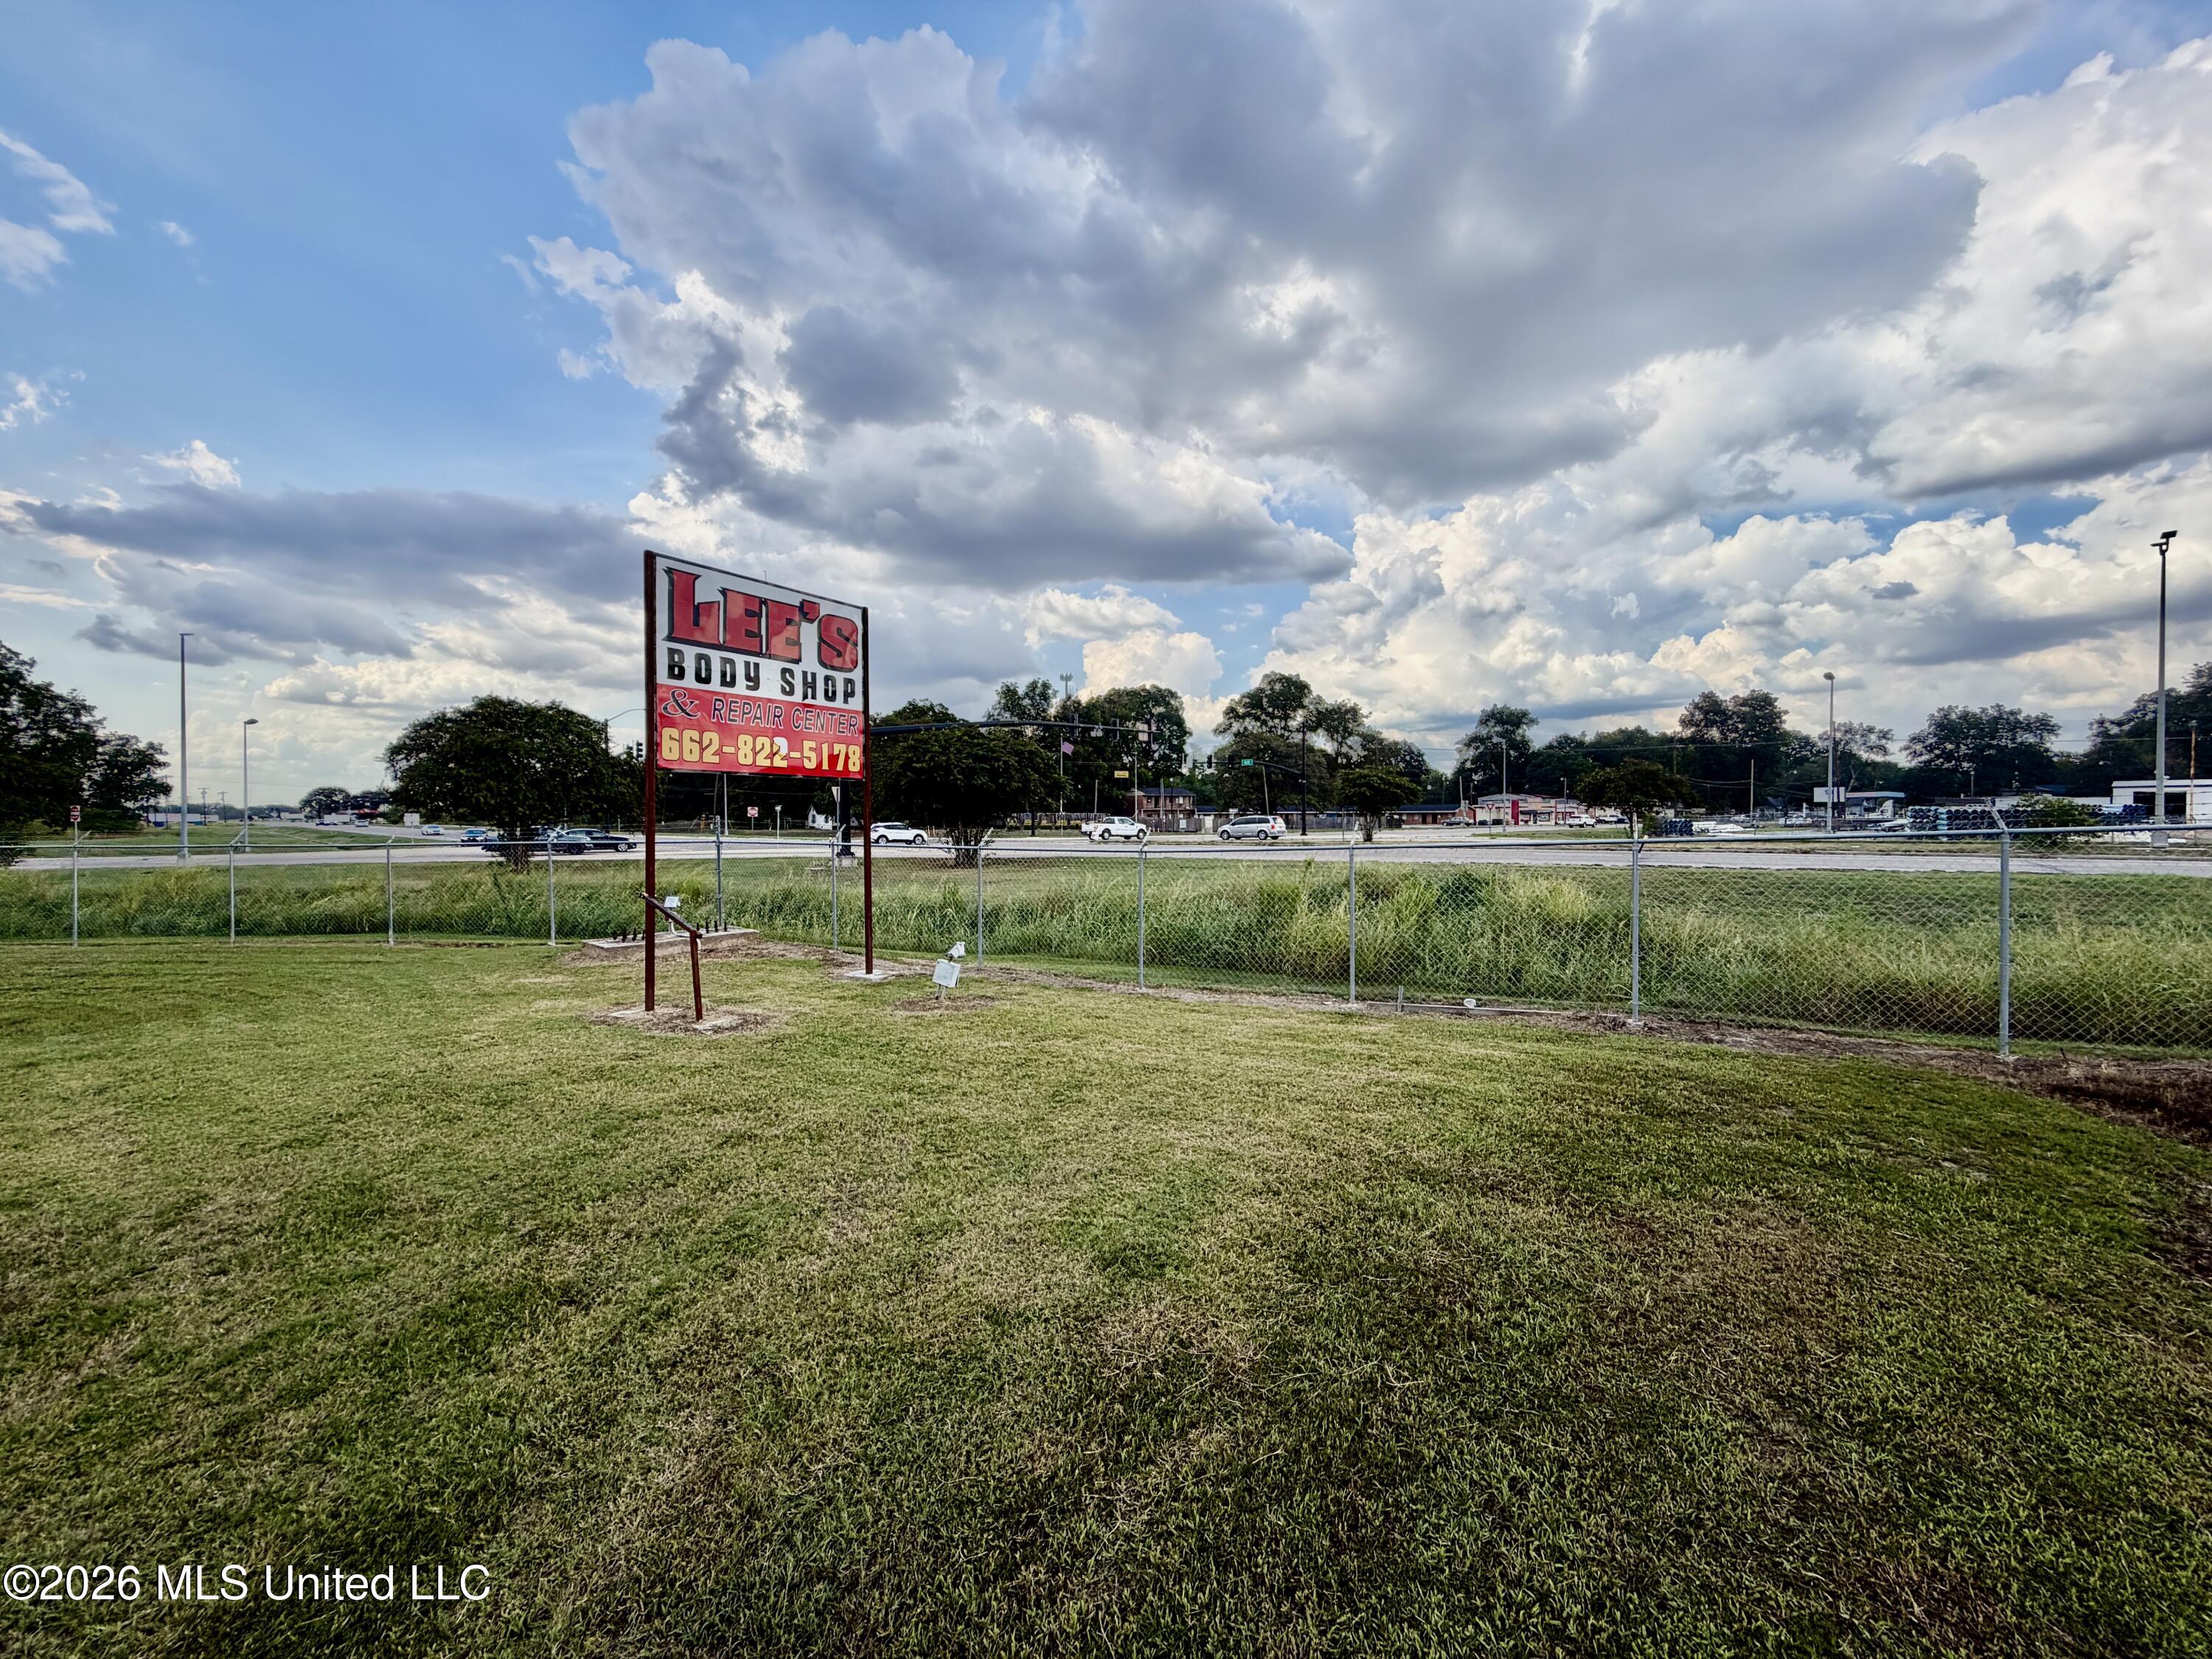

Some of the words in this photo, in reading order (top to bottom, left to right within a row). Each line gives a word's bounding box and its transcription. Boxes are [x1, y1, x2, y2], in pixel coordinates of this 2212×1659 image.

[662, 566, 858, 672] LEE'S
[667, 647, 760, 692] BODY
[780, 667, 856, 704] SHOP
[661, 689, 700, 718] &
[711, 697, 784, 728] REPAIR
[791, 707, 858, 737] CENTER
[661, 726, 861, 773] 662-822-5178
